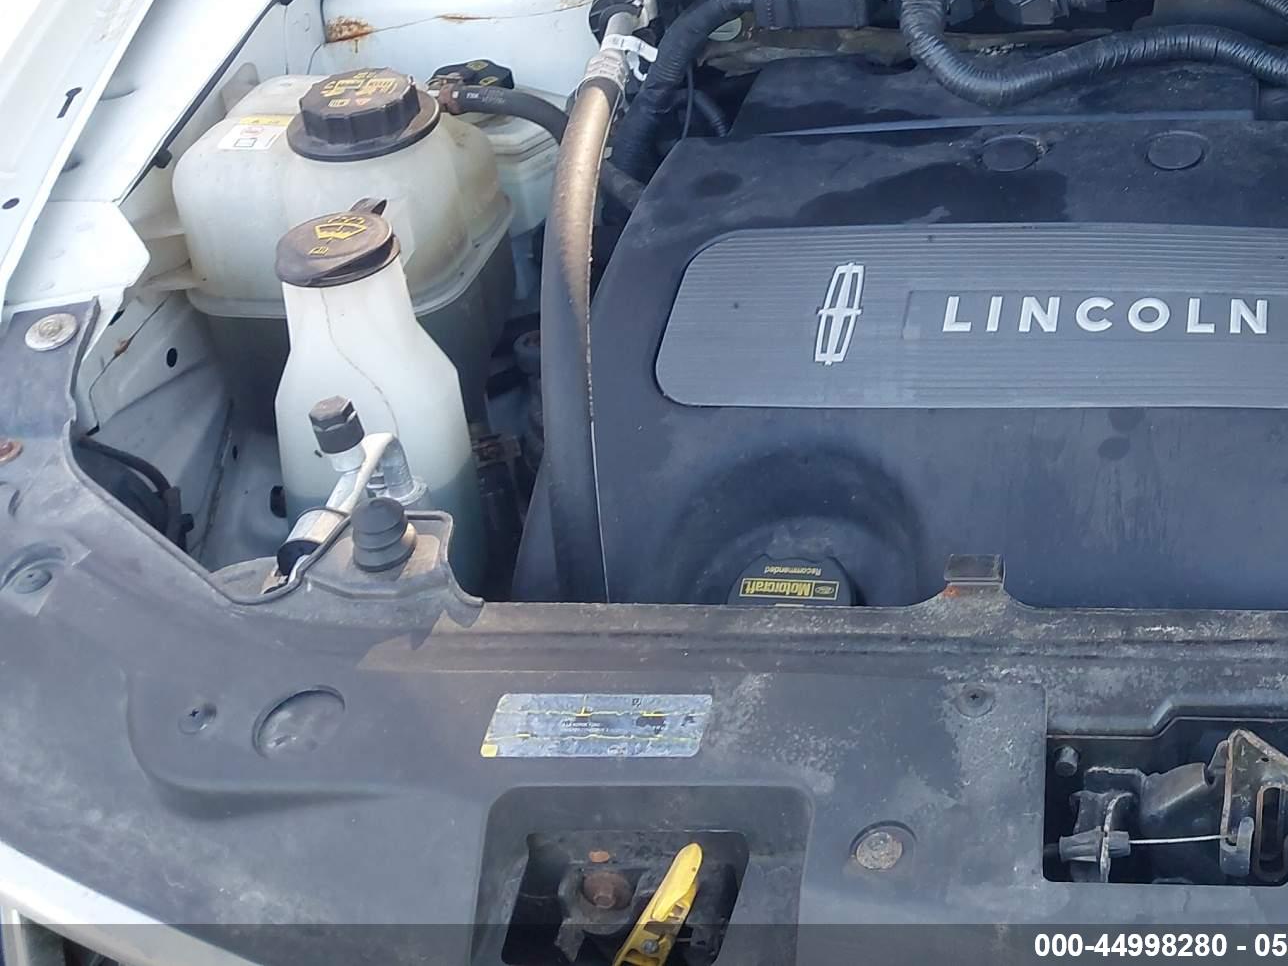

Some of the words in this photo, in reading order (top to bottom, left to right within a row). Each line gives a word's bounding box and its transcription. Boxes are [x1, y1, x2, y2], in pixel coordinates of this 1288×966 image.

[942, 295, 1269, 334] LINCOLN
[764, 565, 822, 576] Recommended
[745, 580, 811, 596] Motorcraft
